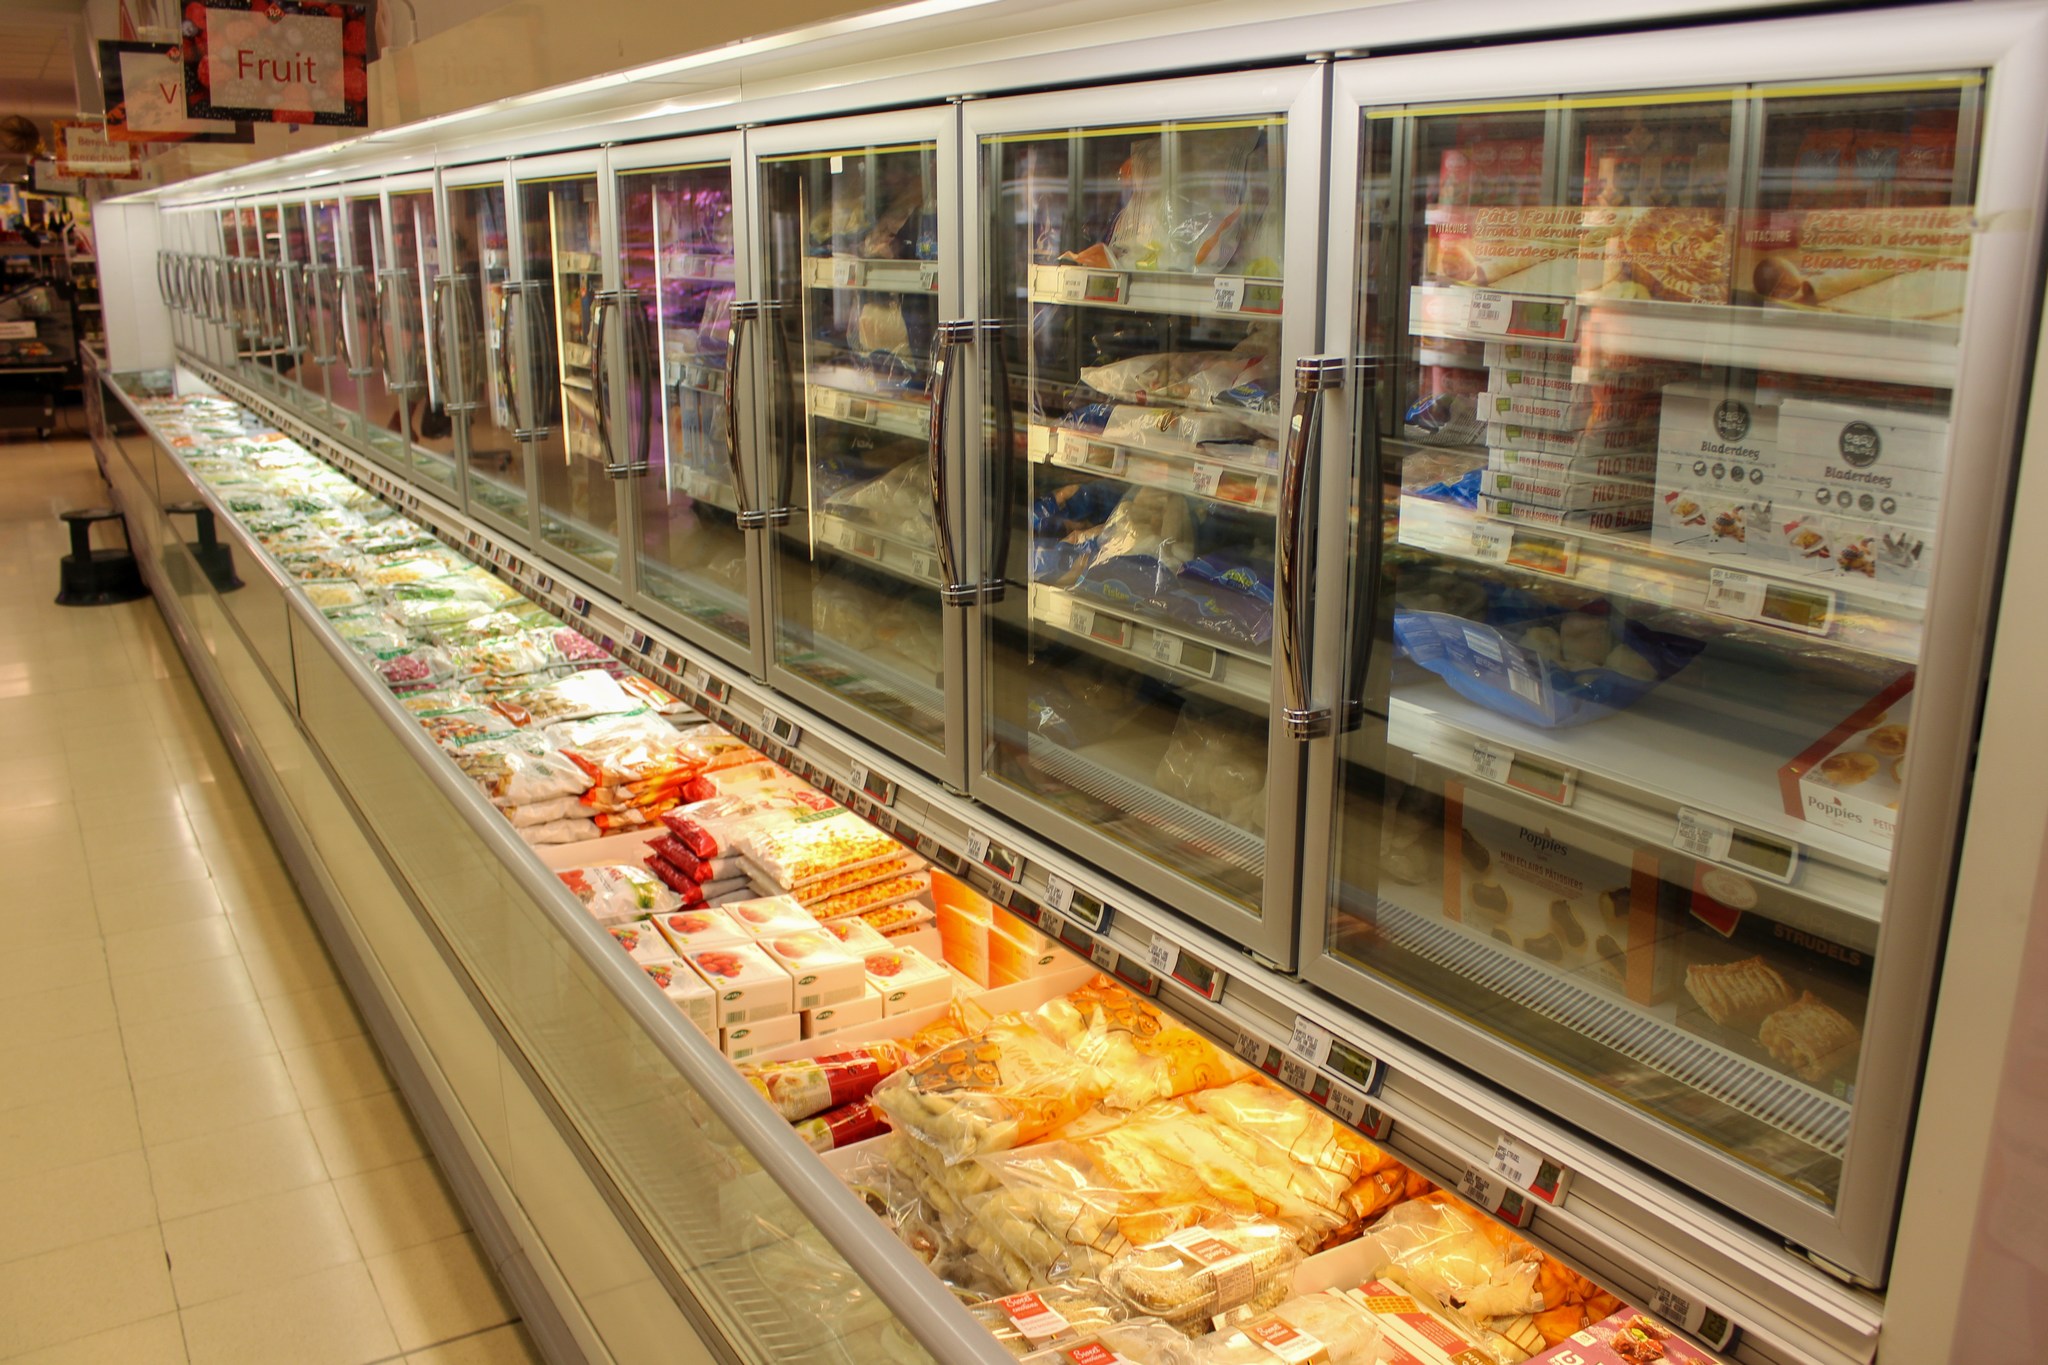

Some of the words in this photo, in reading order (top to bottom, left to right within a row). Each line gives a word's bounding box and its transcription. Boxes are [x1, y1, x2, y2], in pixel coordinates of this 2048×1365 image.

[238, 49, 317, 84] Fruit
[1475, 207, 1517, 225] Pâte
[1804, 211, 1866, 232] Pâte
[1474, 227, 1484, 238] 2
[1486, 226, 1519, 238] ronds
[1535, 226, 1590, 239] dérouler
[1475, 245, 1559, 261] Bladerdeeg
[1800, 254, 1922, 274] Bladerdeeg
[1523, 375, 1536, 386] FILO
[1512, 403, 1524, 414] FILO
[1525, 404, 1561, 418] BLADERDEEG
[1523, 429, 1536, 440] FILO
[1701, 440, 1760, 460] Bladerdeeg
[1597, 458, 1620, 475] FILO
[1512, 480, 1525, 491] FILO
[1824, 465, 1893, 488] Bladerdeeg
[1593, 484, 1617, 502] FILO
[1590, 512, 1613, 530] FILO
[1808, 795, 1863, 824] Poppies
[1520, 826, 1568, 856] Poppies
[1500, 849, 1515, 862] MINI
[1774, 923, 1862, 967] STRUDELS
